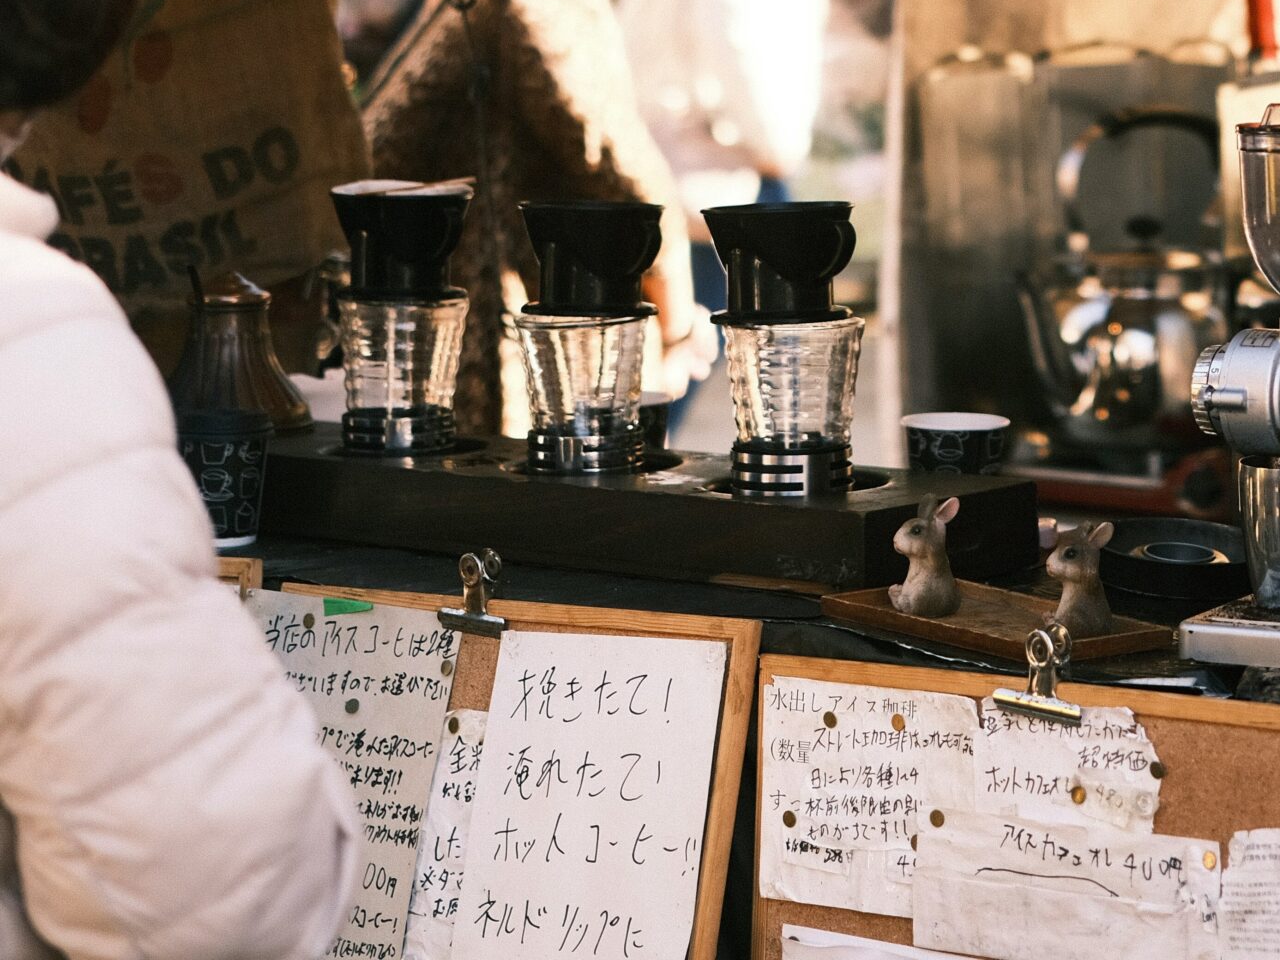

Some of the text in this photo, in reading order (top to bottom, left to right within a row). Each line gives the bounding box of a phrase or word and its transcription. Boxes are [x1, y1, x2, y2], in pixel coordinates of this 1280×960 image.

[202, 126, 300, 200] DO
[769, 688, 918, 719] 水出しアイス珈琲
[474, 889, 644, 959] ネルドリップに
